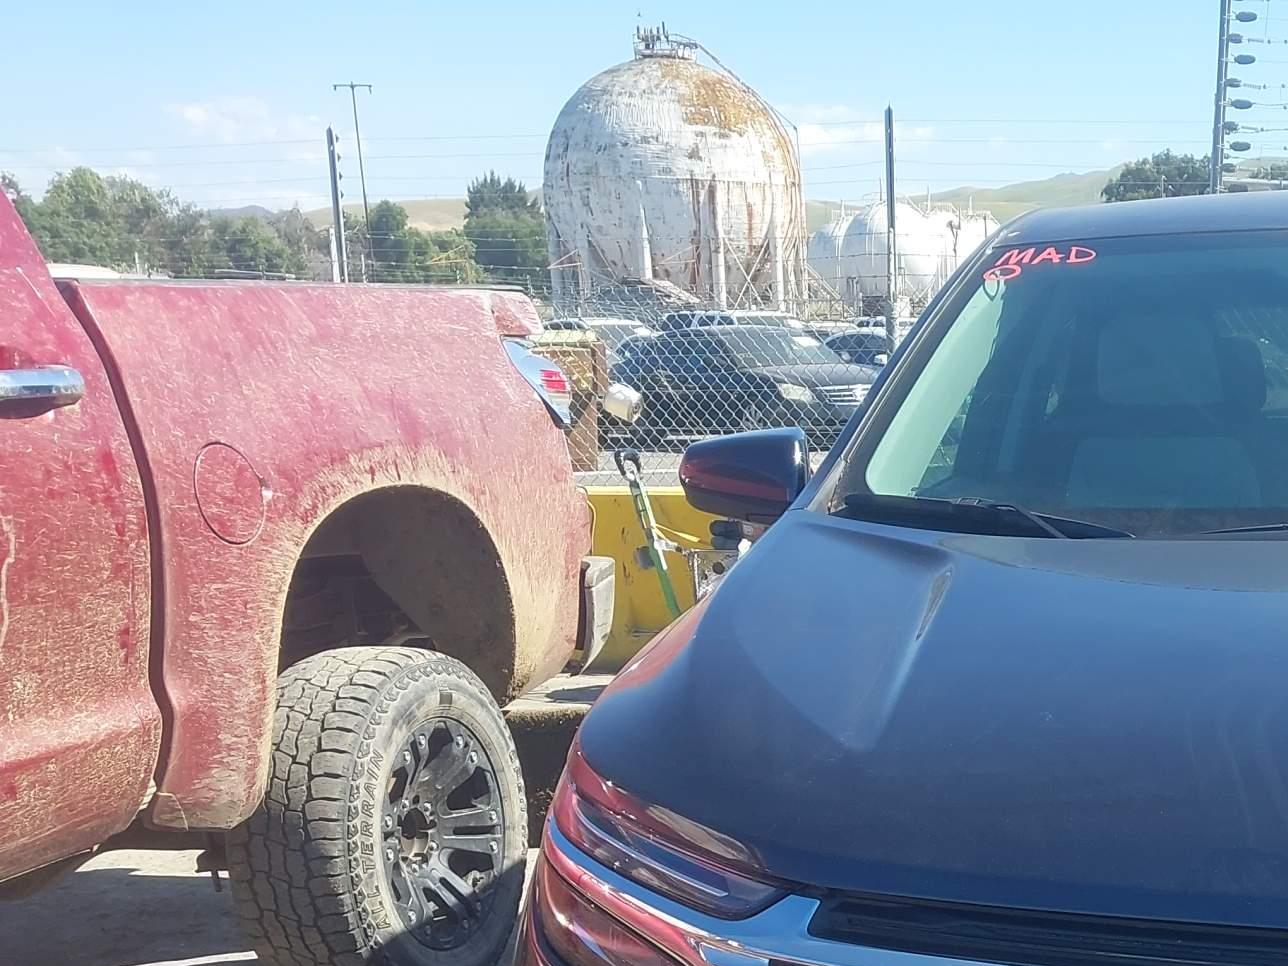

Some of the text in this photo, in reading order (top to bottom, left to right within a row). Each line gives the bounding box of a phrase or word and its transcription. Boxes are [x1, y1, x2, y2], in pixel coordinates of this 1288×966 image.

[994, 246, 1097, 266] MAD
[360, 750, 391, 930] ALL TERRAIN
